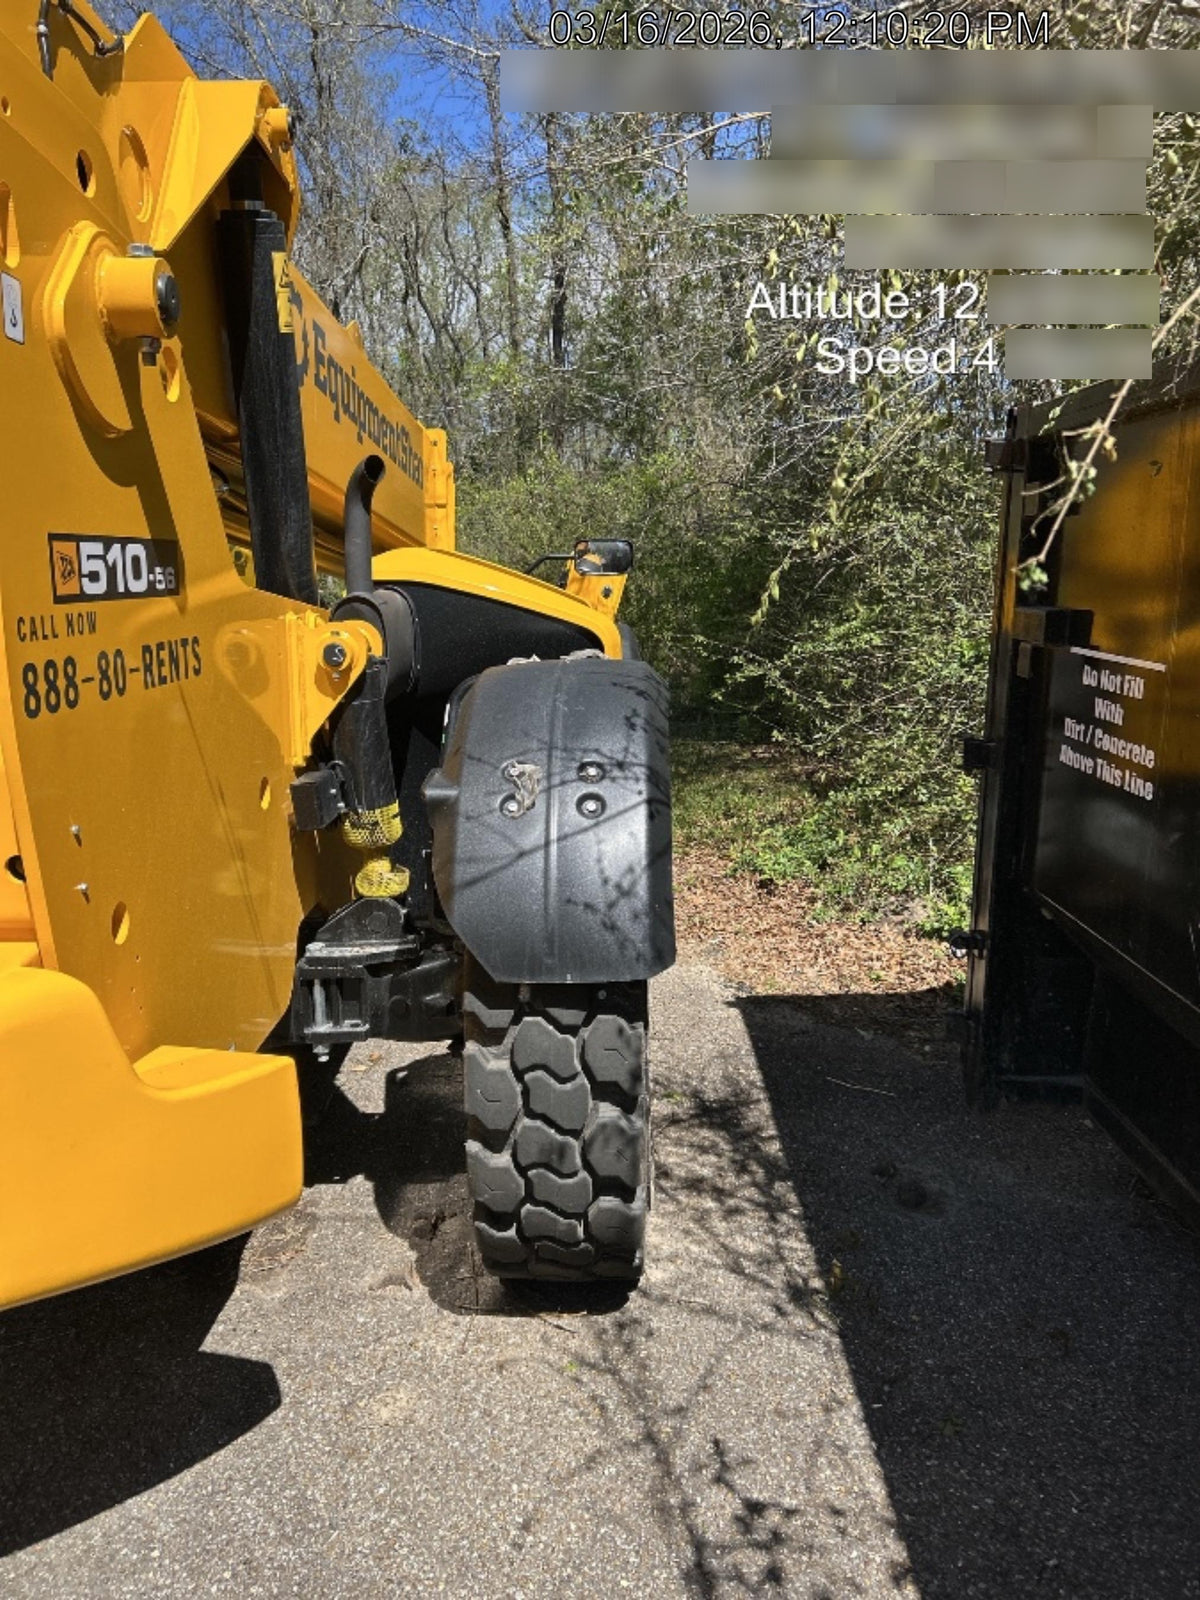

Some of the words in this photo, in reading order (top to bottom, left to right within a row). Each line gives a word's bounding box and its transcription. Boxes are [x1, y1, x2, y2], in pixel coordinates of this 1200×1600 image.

[79, 542, 176, 595] 510-56
[17, 615, 59, 642] CALL
[66, 611, 97, 637] NOW
[22, 636, 202, 719] 888-80-RENTS
[1083, 665, 1097, 687] Do
[1100, 669, 1123, 694] Not
[1123, 675, 1145, 699] Fill
[1094, 697, 1125, 726] With
[1064, 717, 1086, 743] Dirt
[1086, 725, 1093, 744] /
[1094, 728, 1156, 769] Concrete
[1059, 744, 1095, 775] Above
[1096, 758, 1123, 788] This
[1123, 769, 1154, 801] Line
